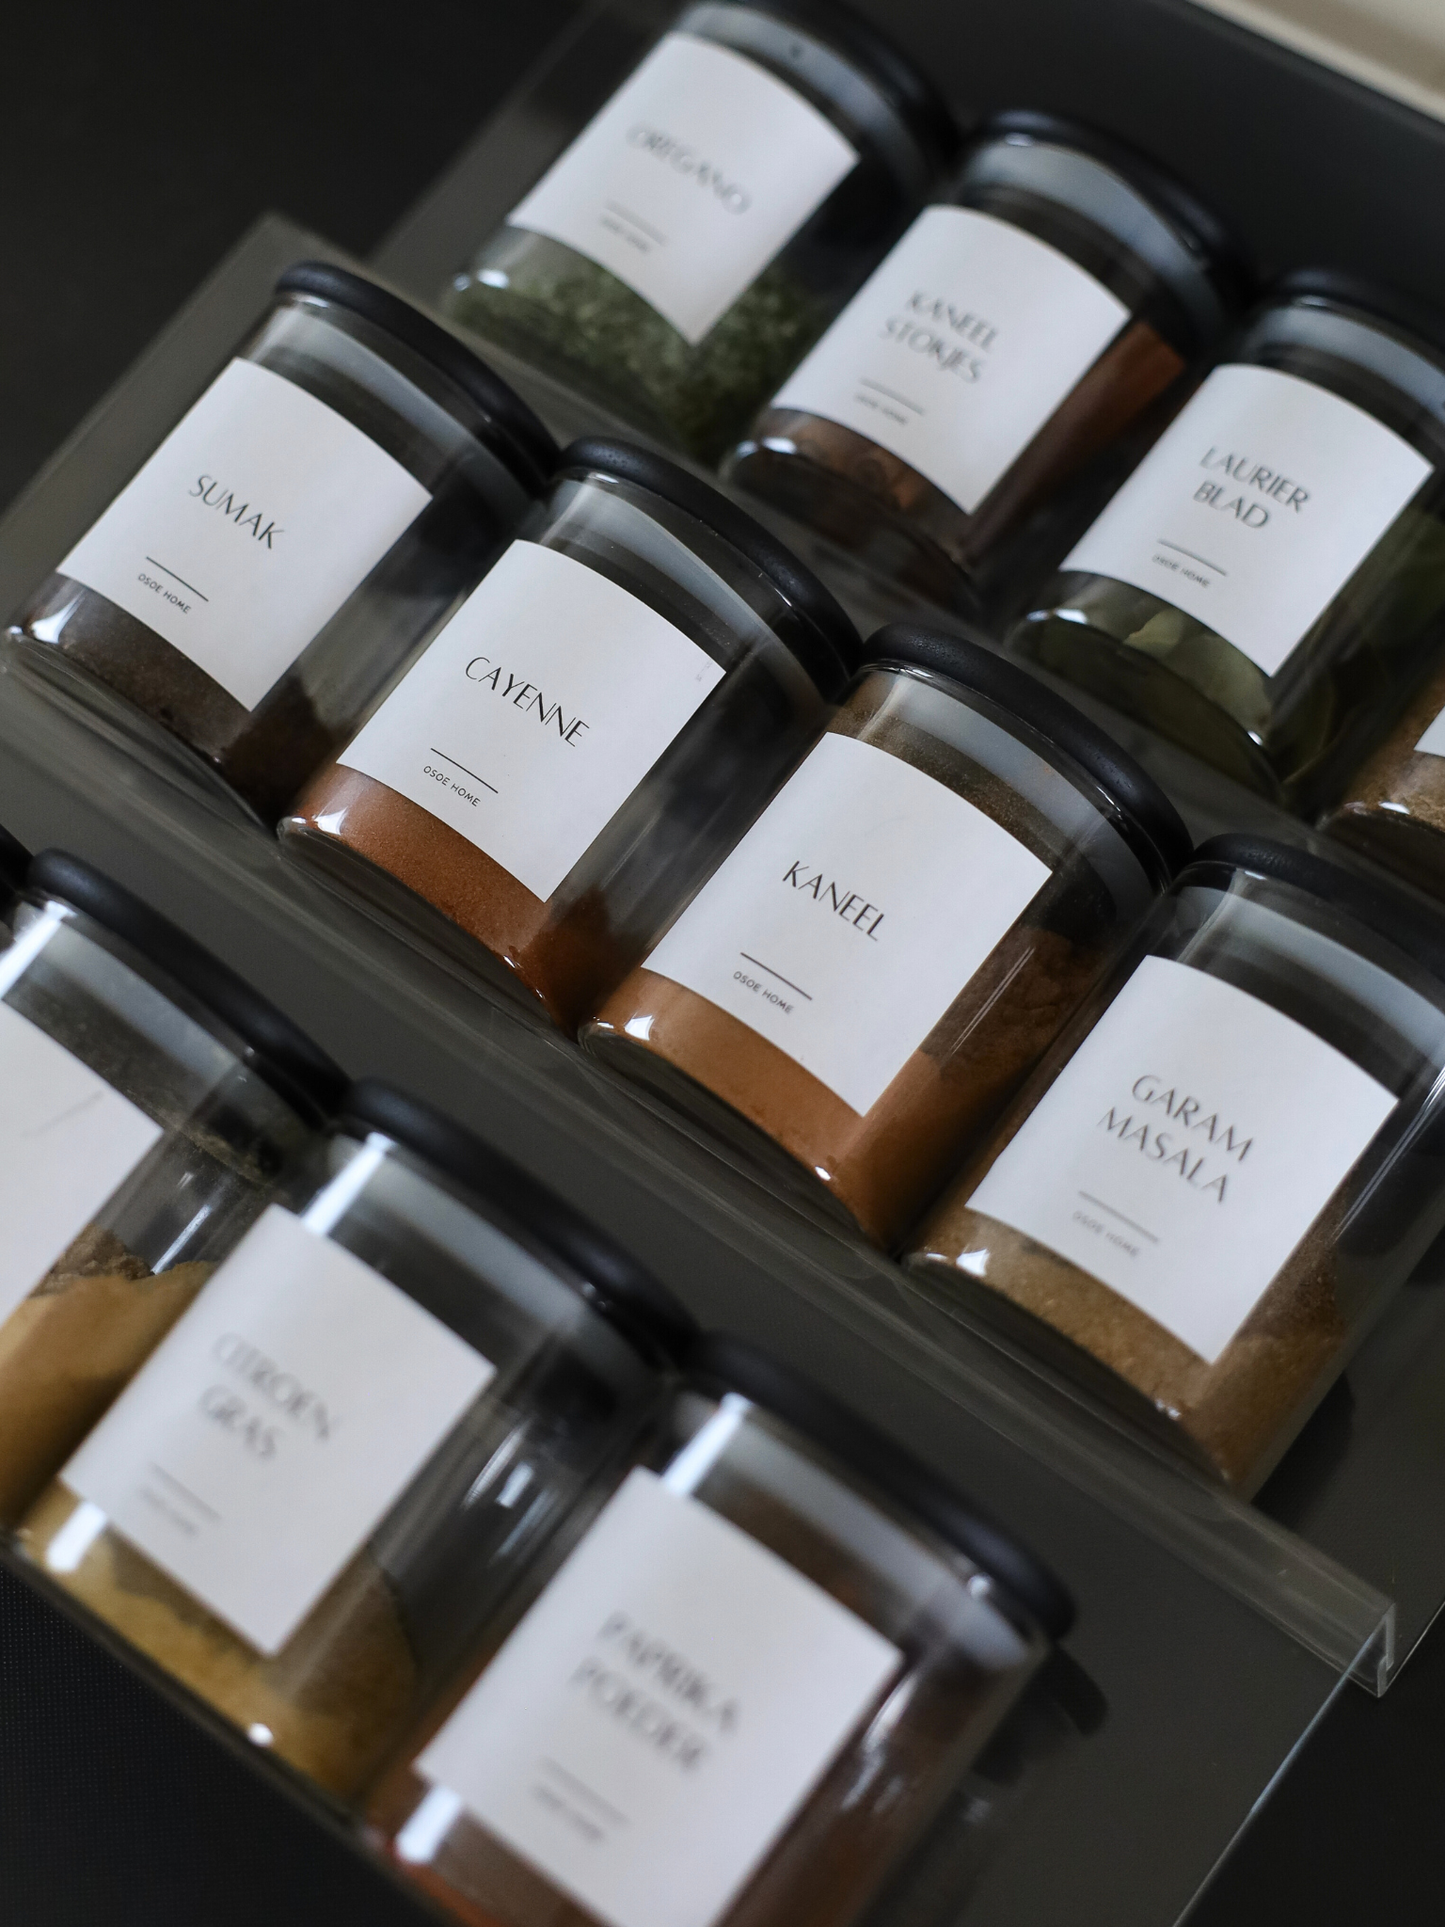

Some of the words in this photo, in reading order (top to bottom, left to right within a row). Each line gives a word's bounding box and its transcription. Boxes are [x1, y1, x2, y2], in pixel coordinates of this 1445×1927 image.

[188, 473, 285, 550] SUMAK
[1193, 480, 1270, 529] BLAD
[1199, 447, 1310, 514] LAURIER
[137, 572, 164, 594] OSOE
[163, 590, 192, 615] HOME
[464, 656, 590, 748] CAYENNE
[422, 765, 451, 787] OSOE
[450, 782, 481, 808] HOME
[782, 860, 885, 942] KANEEL
[732, 970, 762, 993] OSOE
[761, 988, 794, 1015] HOME
[1096, 1105, 1228, 1203] MASALA
[1131, 1074, 1254, 1162] GARAM
